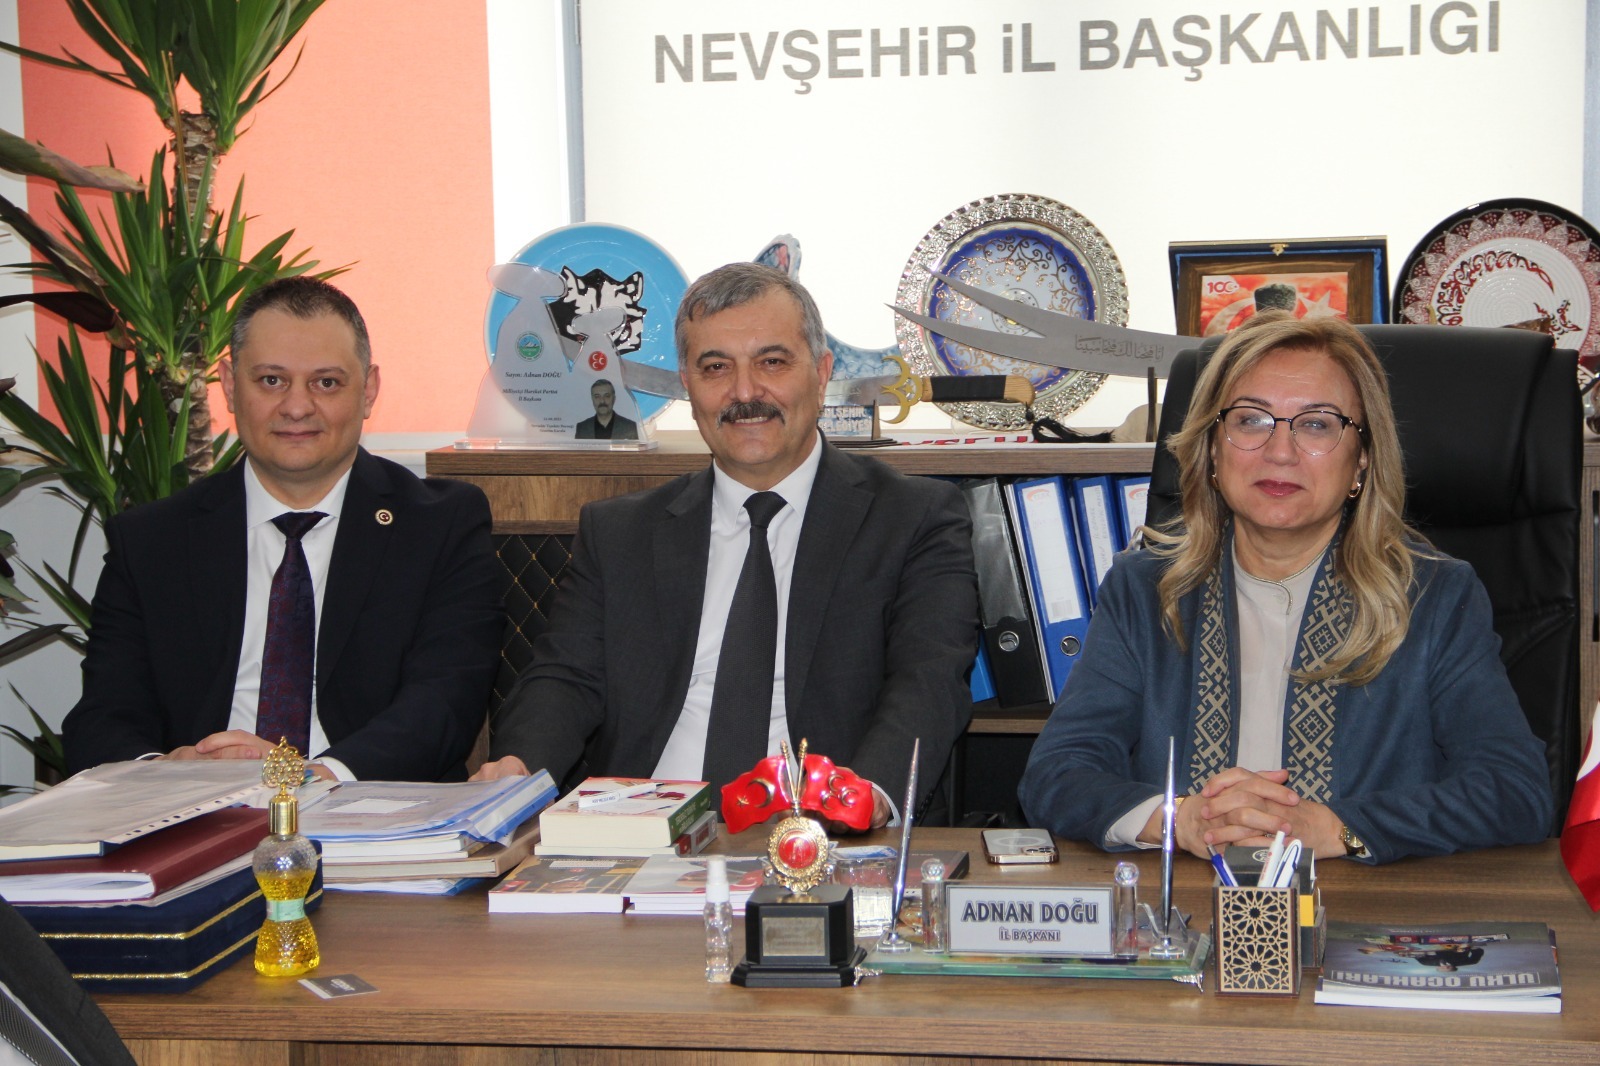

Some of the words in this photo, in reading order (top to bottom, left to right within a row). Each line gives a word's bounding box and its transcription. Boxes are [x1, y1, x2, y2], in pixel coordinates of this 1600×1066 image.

[961, 901, 1034, 923] ADNAN
[1040, 897, 1099, 924] DOĞU
[999, 926, 1010, 941] İL
[1011, 928, 1061, 943] BAŞKANI
